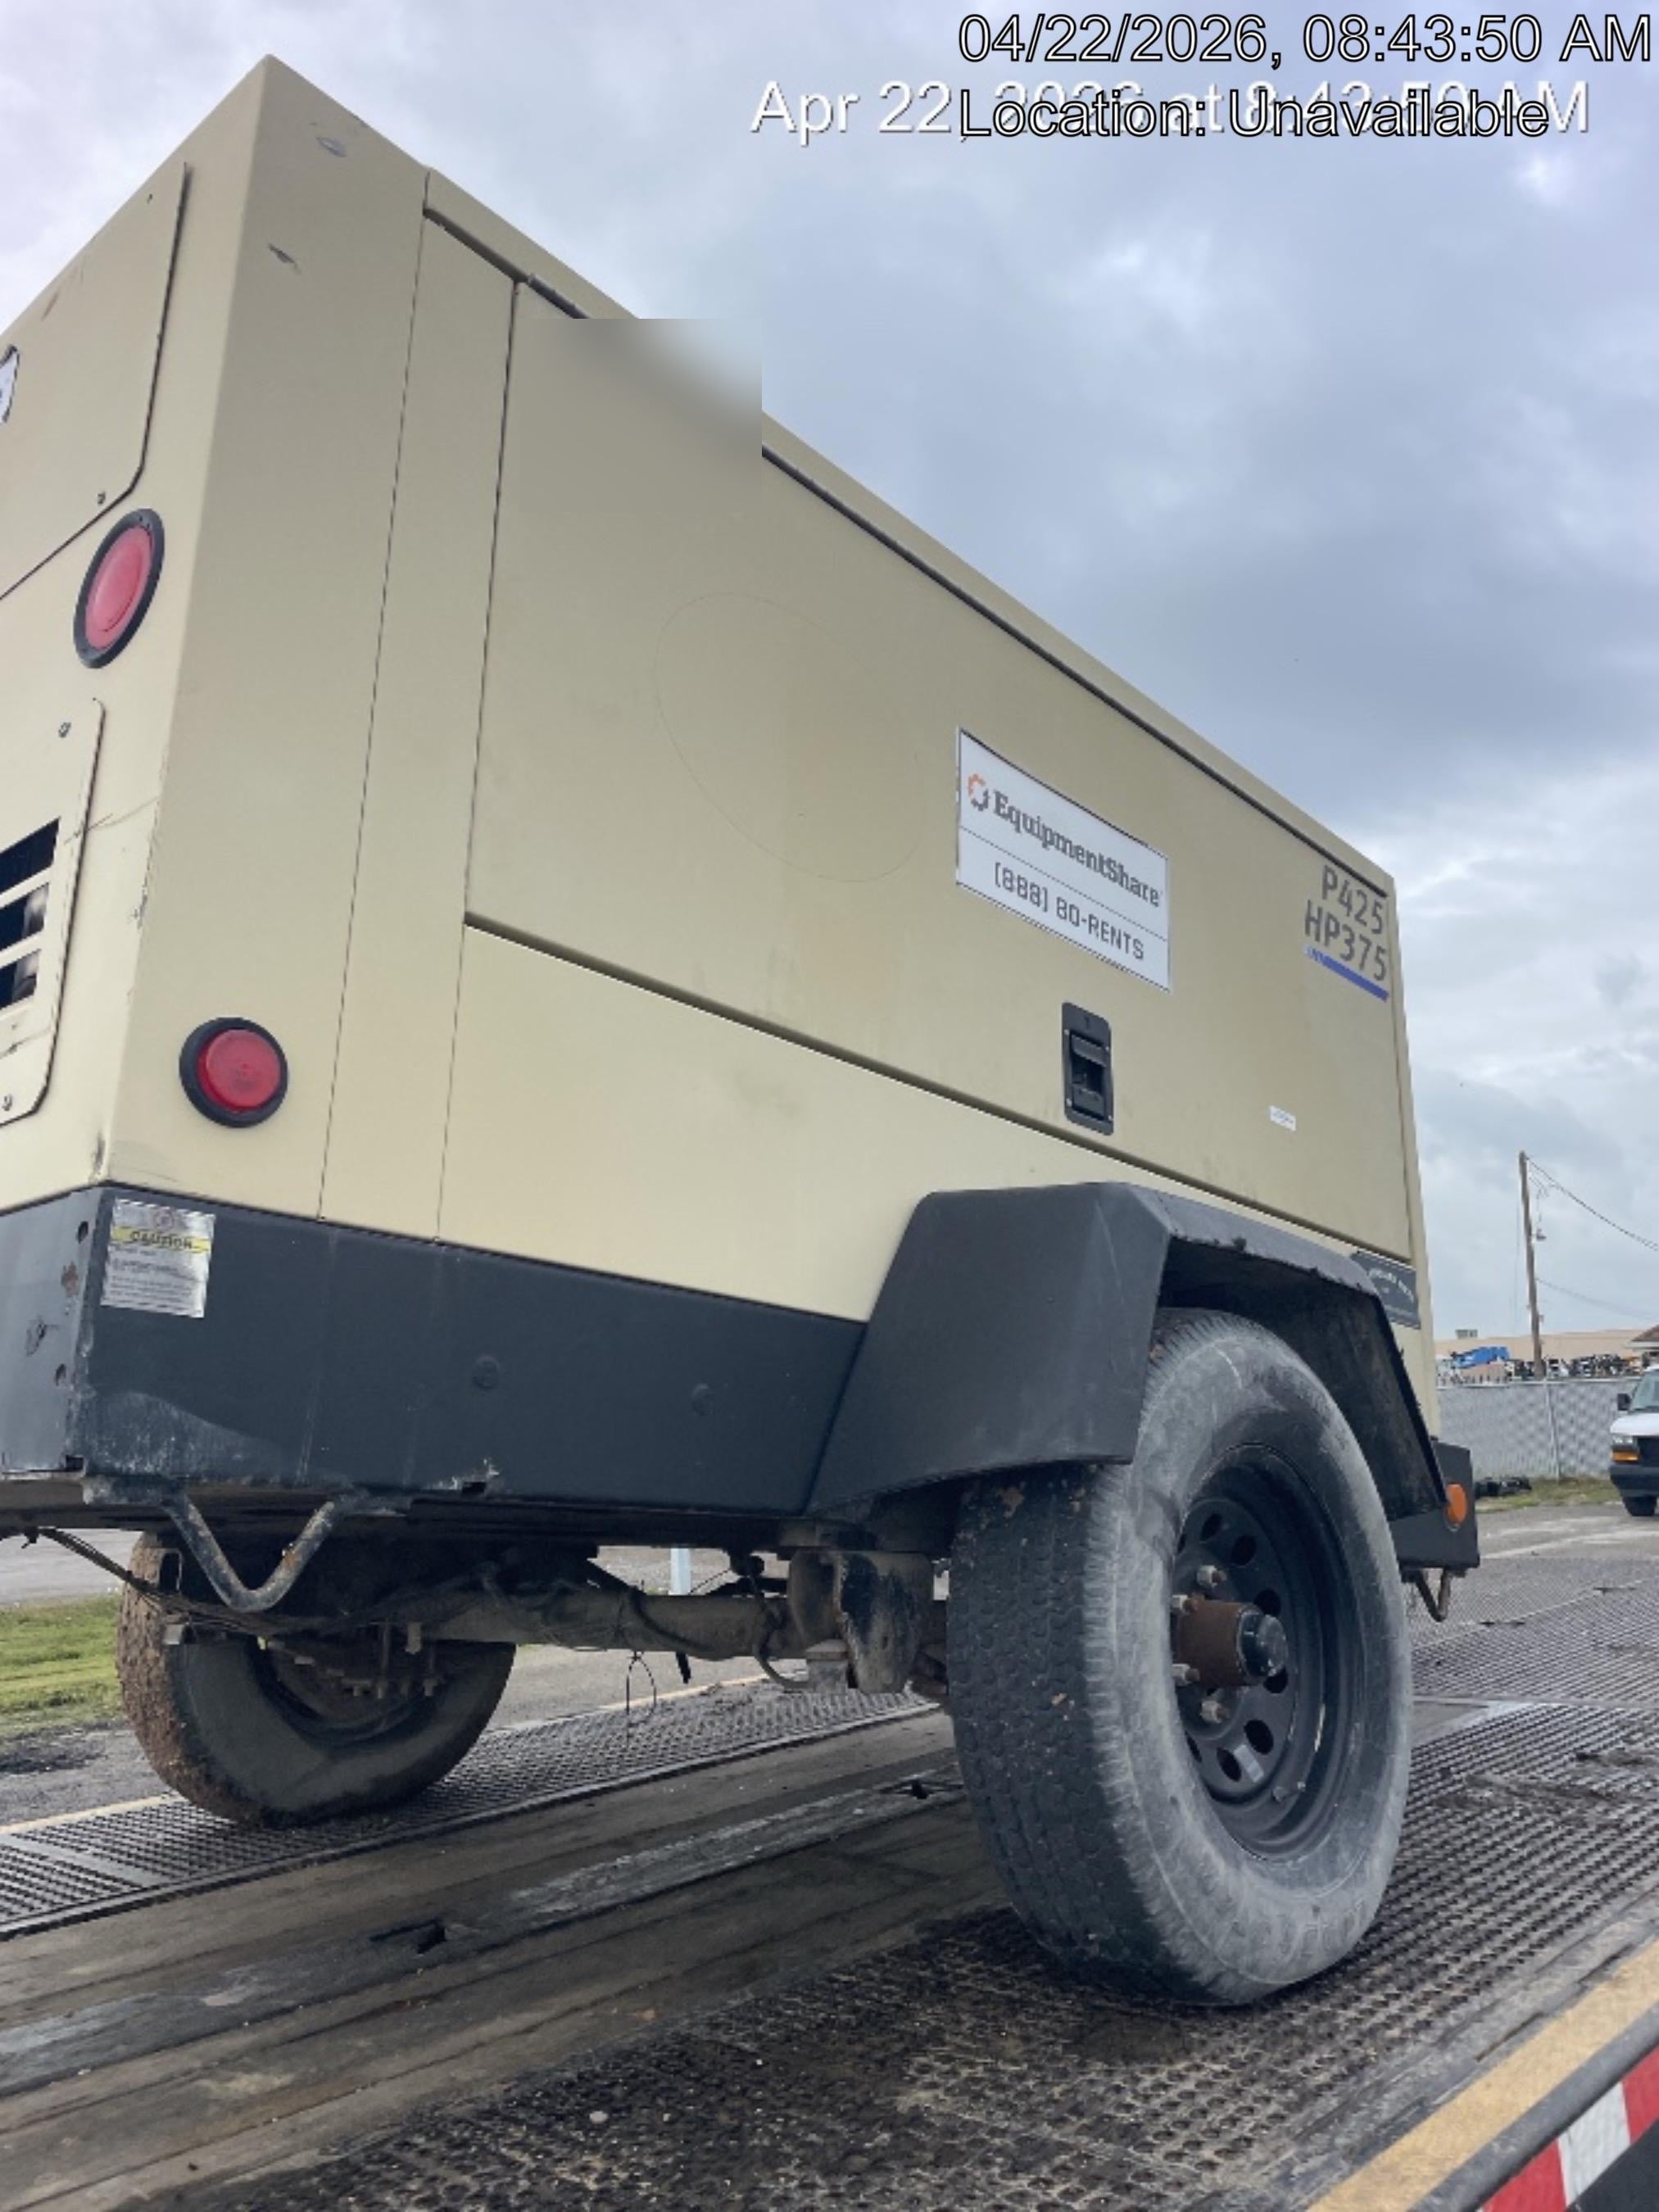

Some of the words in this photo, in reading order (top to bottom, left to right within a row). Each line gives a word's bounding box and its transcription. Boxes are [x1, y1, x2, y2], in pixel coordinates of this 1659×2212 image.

[992, 788, 1160, 908] EquipmentShare
[994, 861, 1049, 913] (888)
[1056, 895, 1145, 960] 80-RENTS
[1304, 899, 1387, 981] HP375
[1321, 863, 1383, 935] P425
